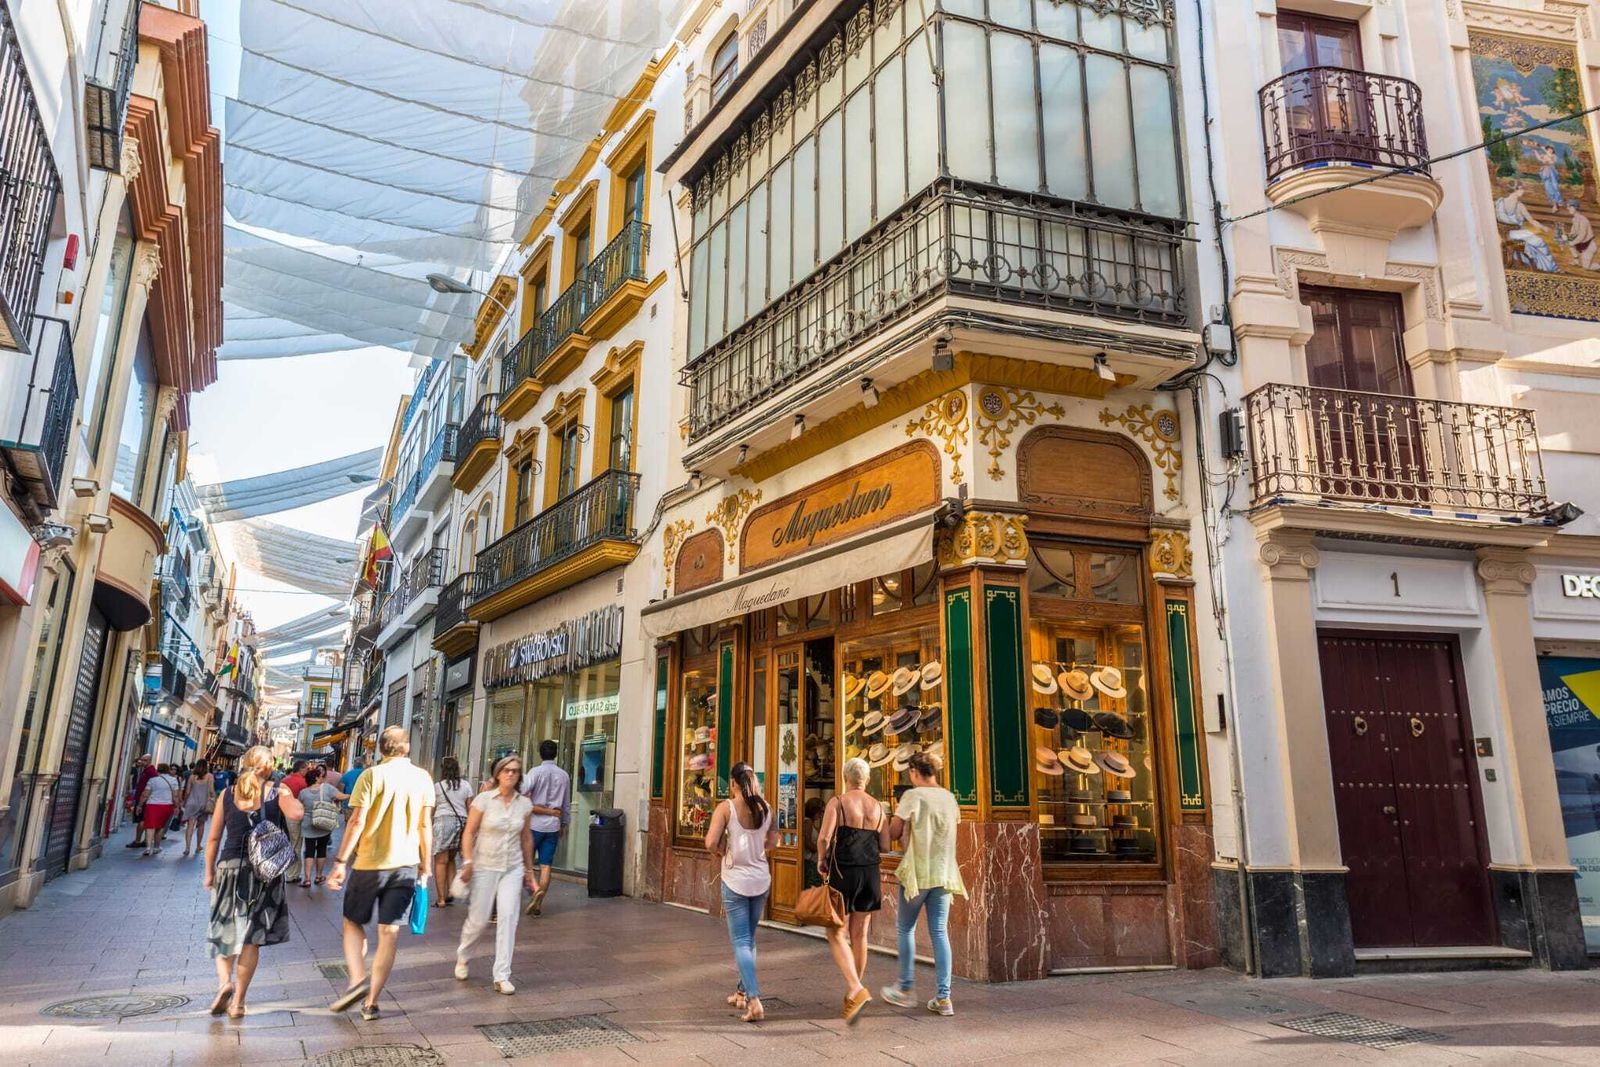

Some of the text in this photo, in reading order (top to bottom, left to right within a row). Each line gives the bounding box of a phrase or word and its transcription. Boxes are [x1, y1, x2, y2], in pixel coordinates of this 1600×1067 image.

[772, 480, 892, 547] Maquedano
[726, 582, 791, 614] Maquedano
[1390, 571, 1401, 597] 1
[519, 633, 568, 666] SWAROVSKI
[1553, 710, 1591, 727] SIEMPRE
